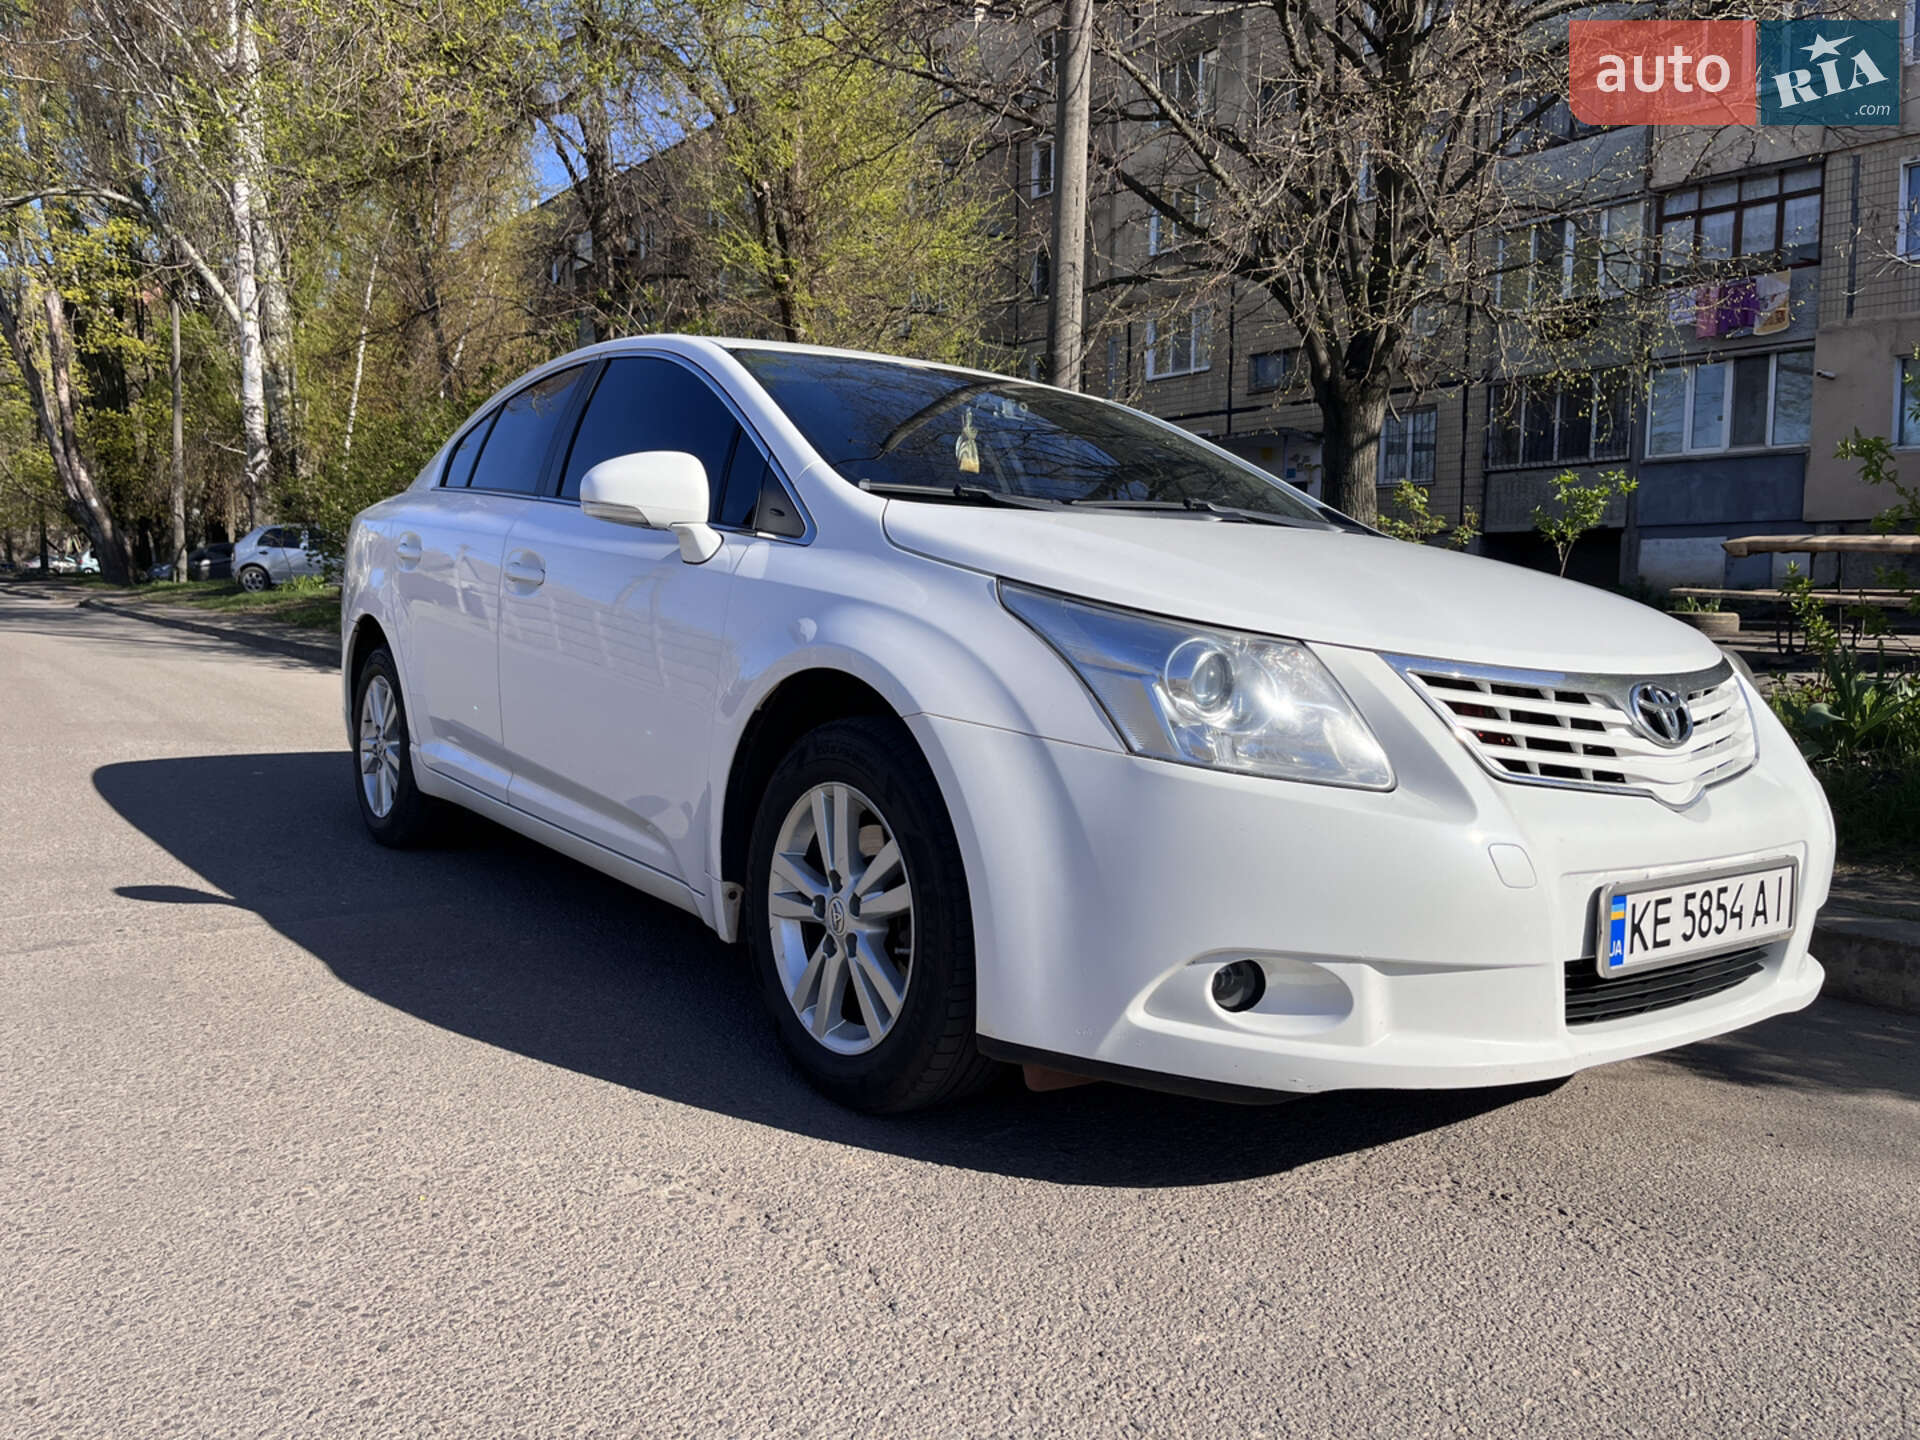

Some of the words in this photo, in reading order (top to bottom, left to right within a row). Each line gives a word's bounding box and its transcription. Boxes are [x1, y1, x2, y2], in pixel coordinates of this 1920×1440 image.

[1629, 897, 1672, 954] KE
[1681, 883, 1744, 942] 5854
[1751, 876, 1783, 927] AI
